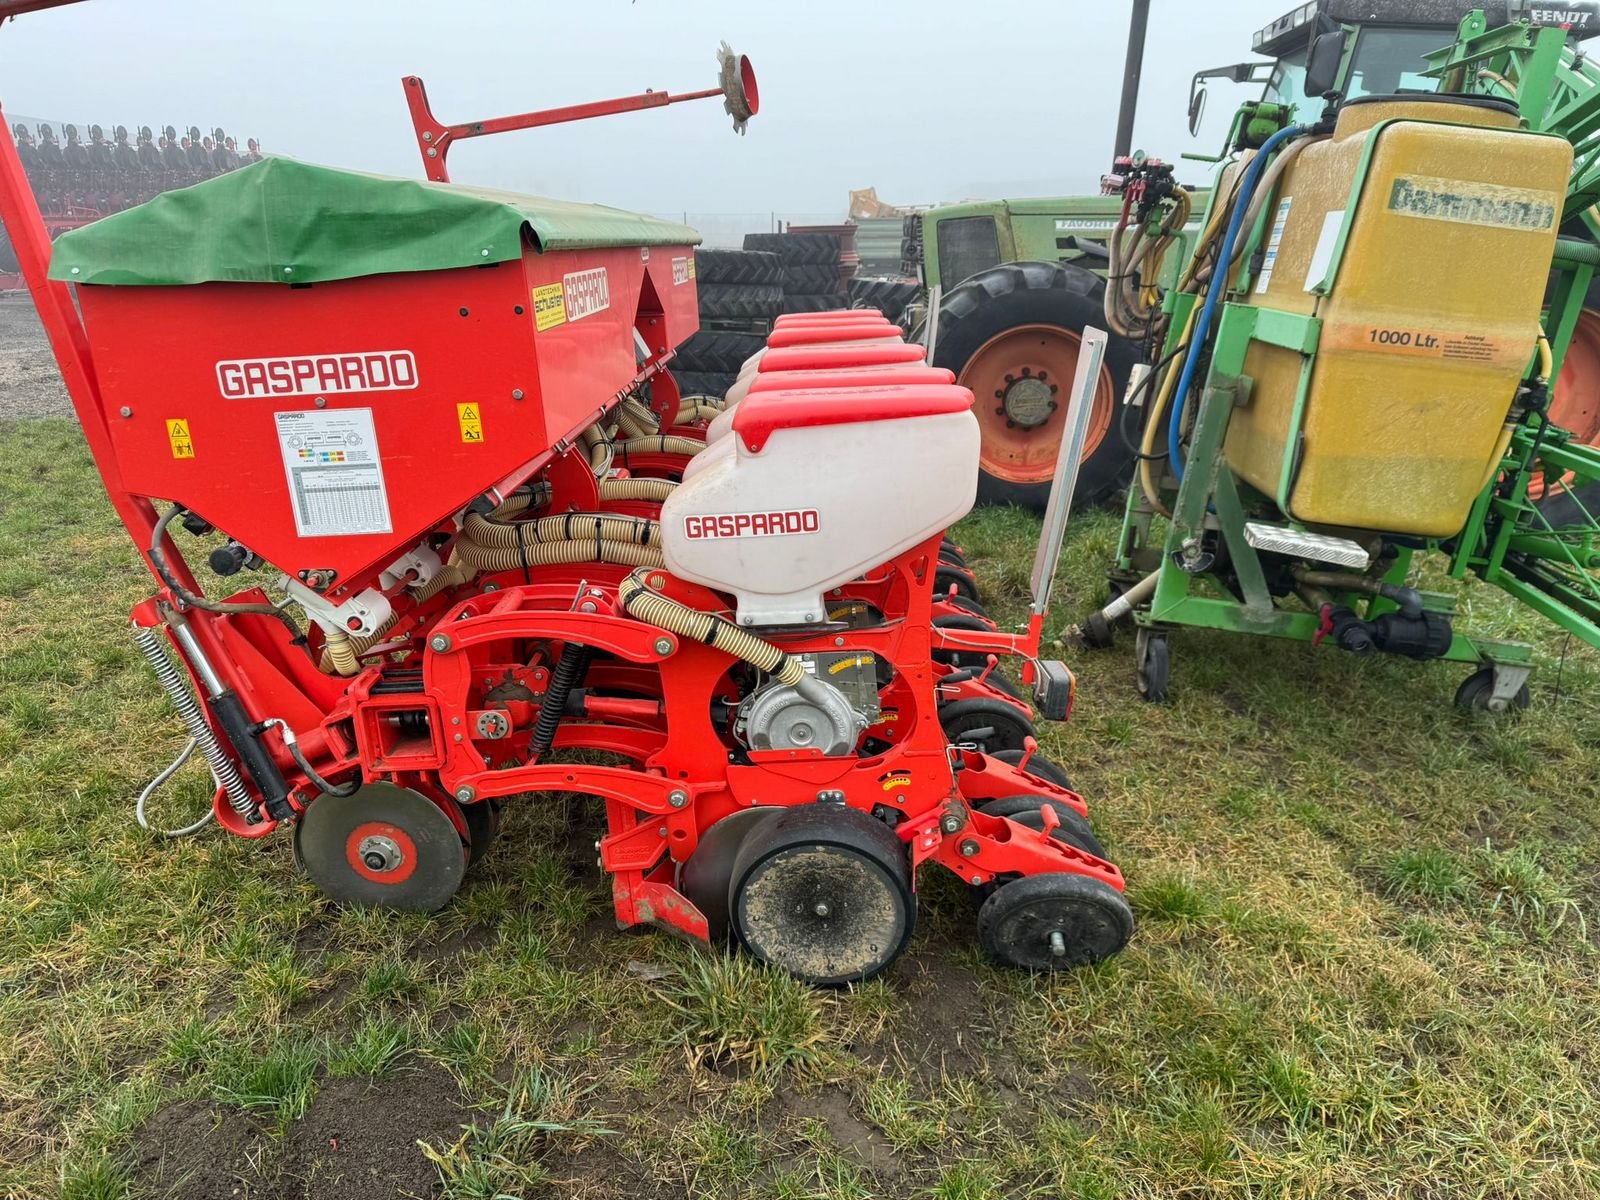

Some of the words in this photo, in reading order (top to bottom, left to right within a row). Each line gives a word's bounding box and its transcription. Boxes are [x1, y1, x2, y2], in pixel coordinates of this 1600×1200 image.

[1531, 9, 1593, 24] FENDT
[565, 270, 609, 319] GASPARDO
[1369, 328, 1412, 346] 1000
[1414, 332, 1440, 349] Ltr.
[219, 353, 415, 397] GASPARDO
[685, 510, 819, 539] GASPARDO
